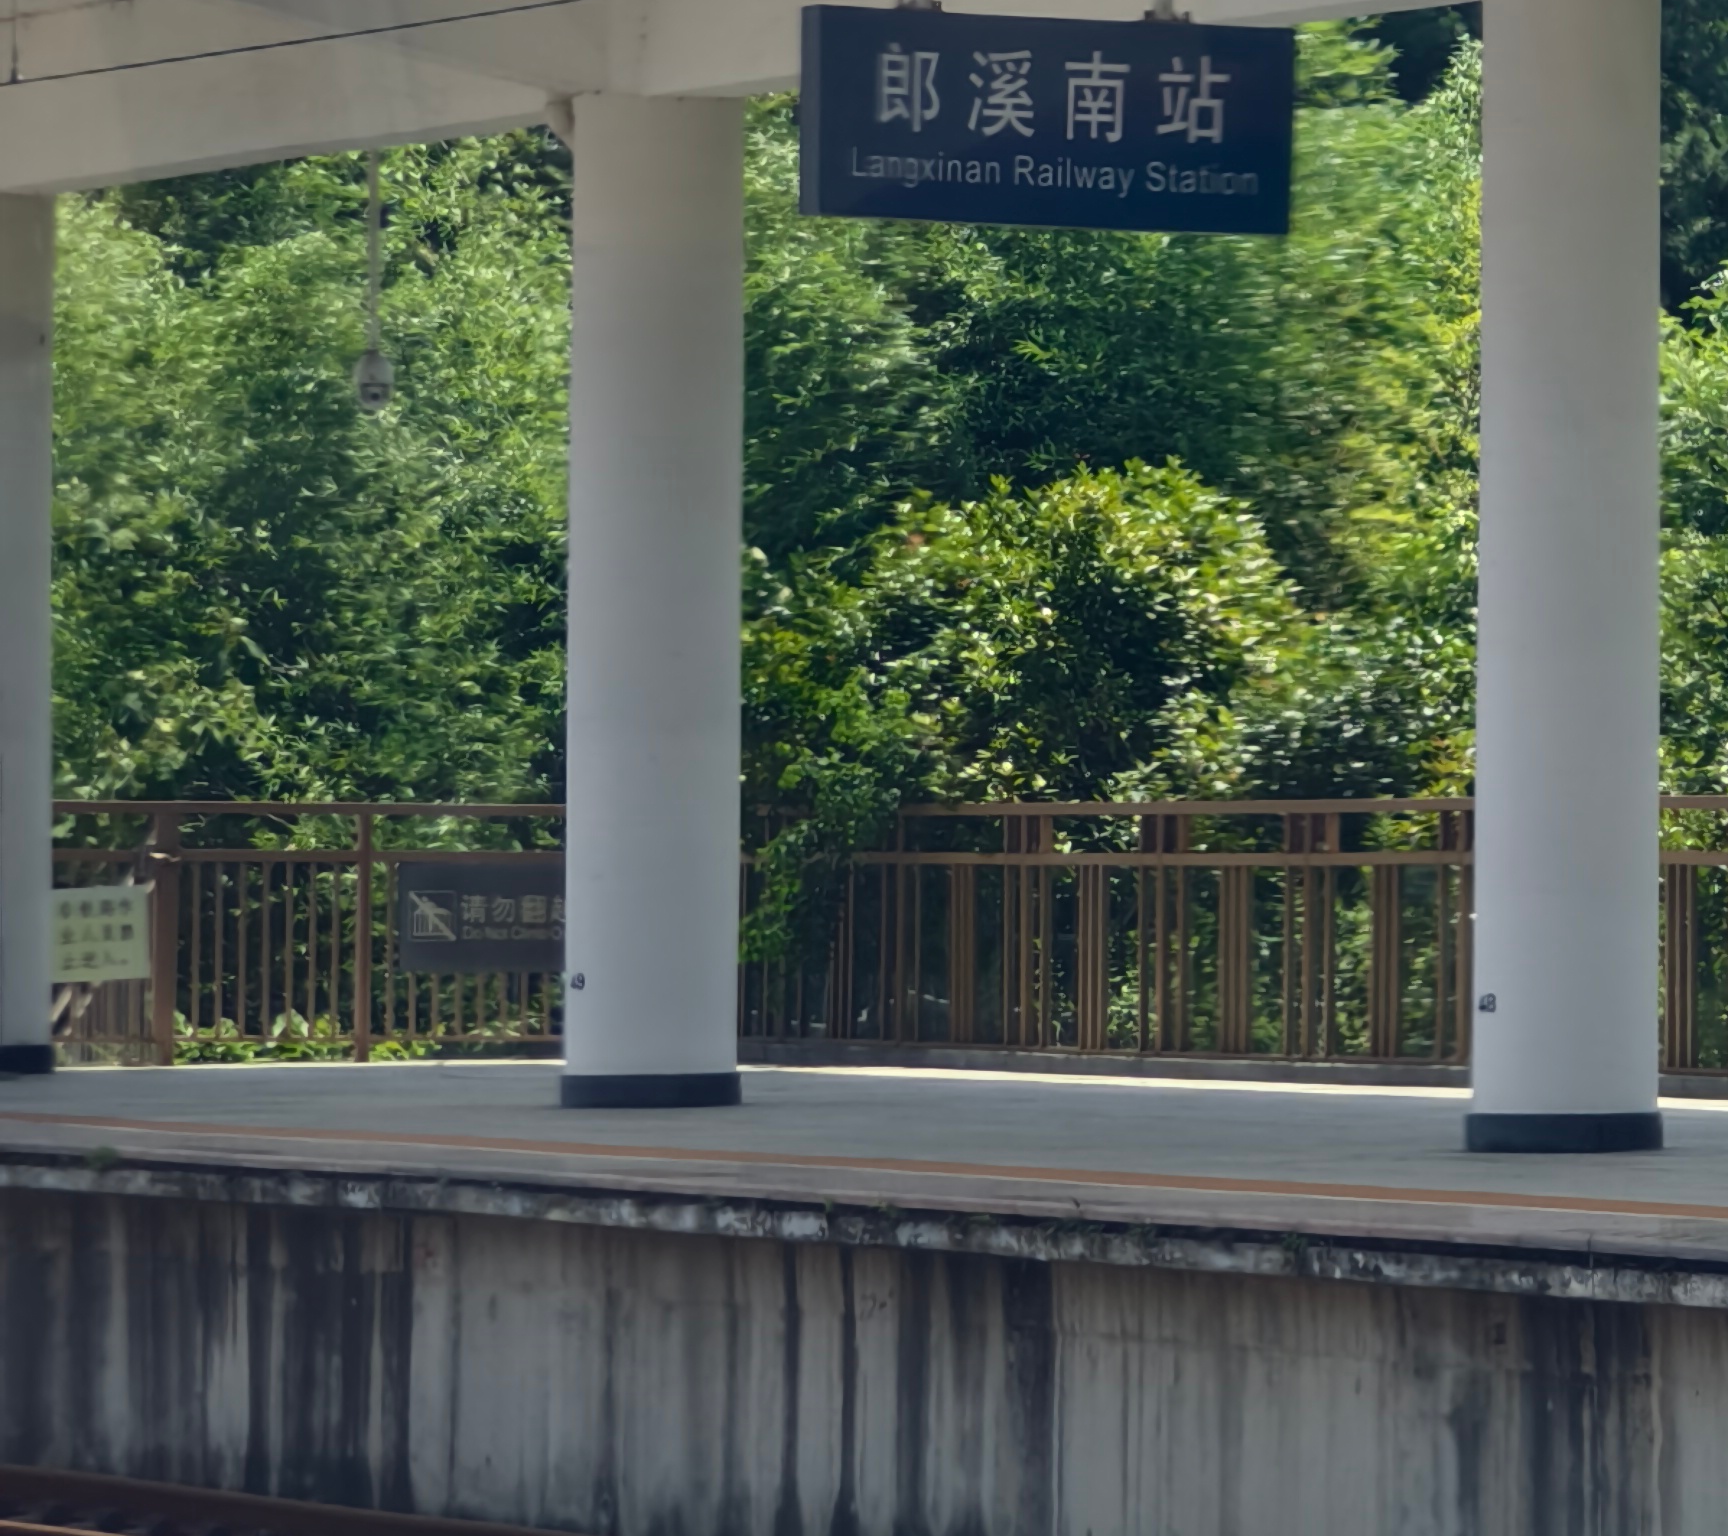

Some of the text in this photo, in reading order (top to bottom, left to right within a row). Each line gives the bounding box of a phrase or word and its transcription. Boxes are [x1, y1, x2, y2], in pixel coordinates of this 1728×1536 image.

[876, 42, 1232, 145] 郎溪南站
[851, 146, 1259, 198] Langxinan Railway Station
